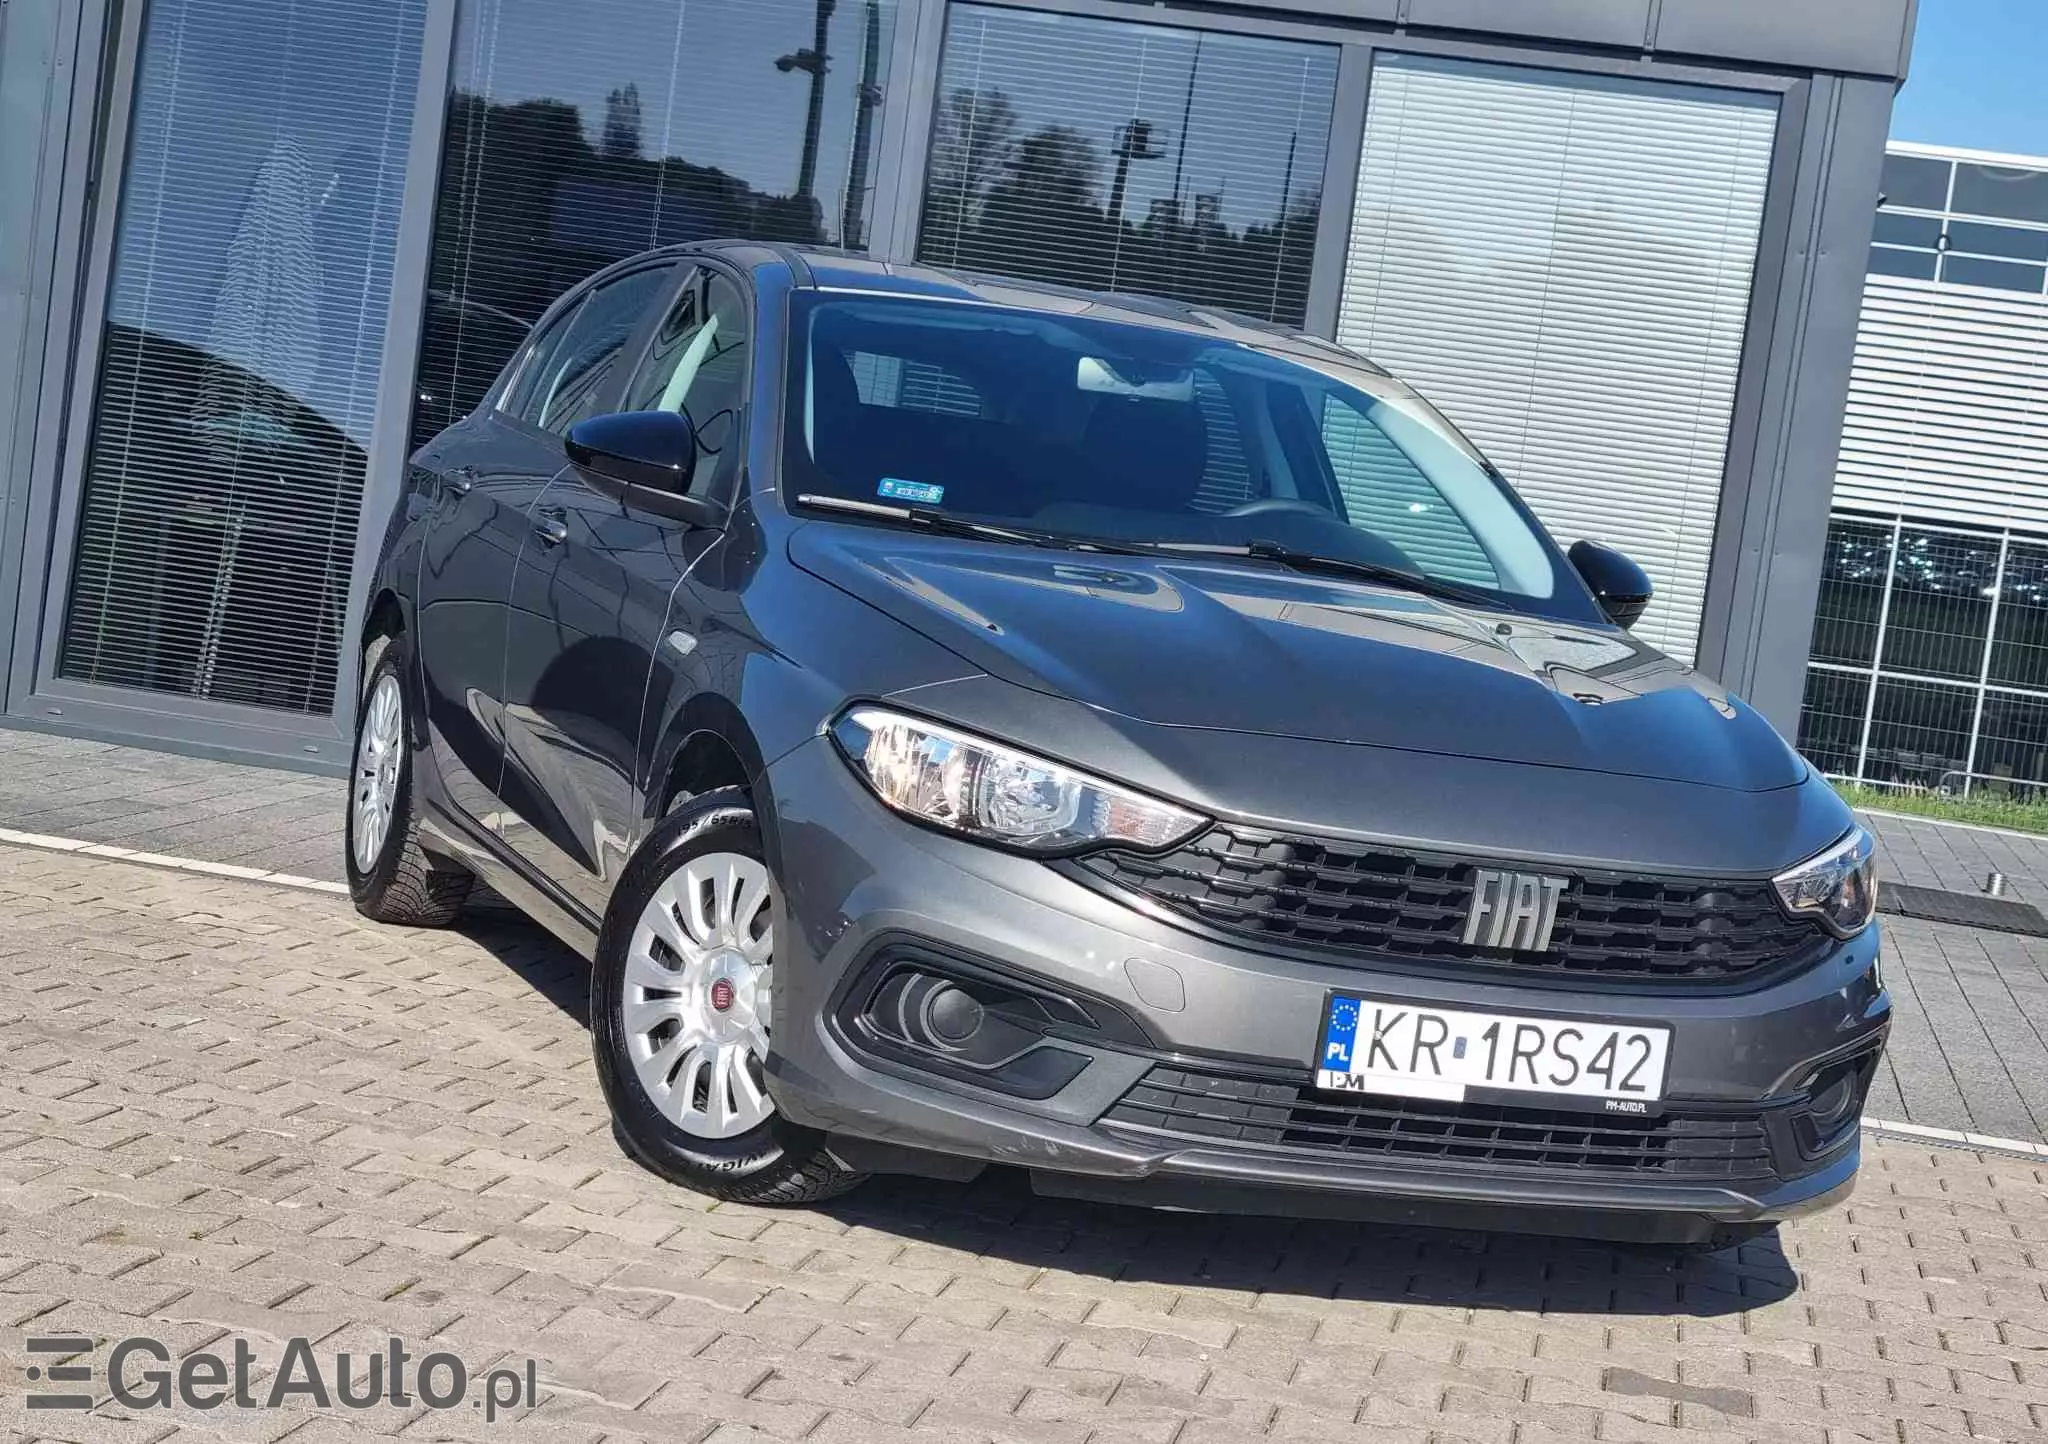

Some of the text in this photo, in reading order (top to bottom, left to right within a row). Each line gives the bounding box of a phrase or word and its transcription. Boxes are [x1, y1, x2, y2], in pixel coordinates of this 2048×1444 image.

[1462, 869, 1570, 952] FIAT
[1327, 1041, 1349, 1061] PL
[1367, 1008, 1653, 1093] KR 1RS42
[1605, 1099, 1648, 1113] PM-AUTO.PL
